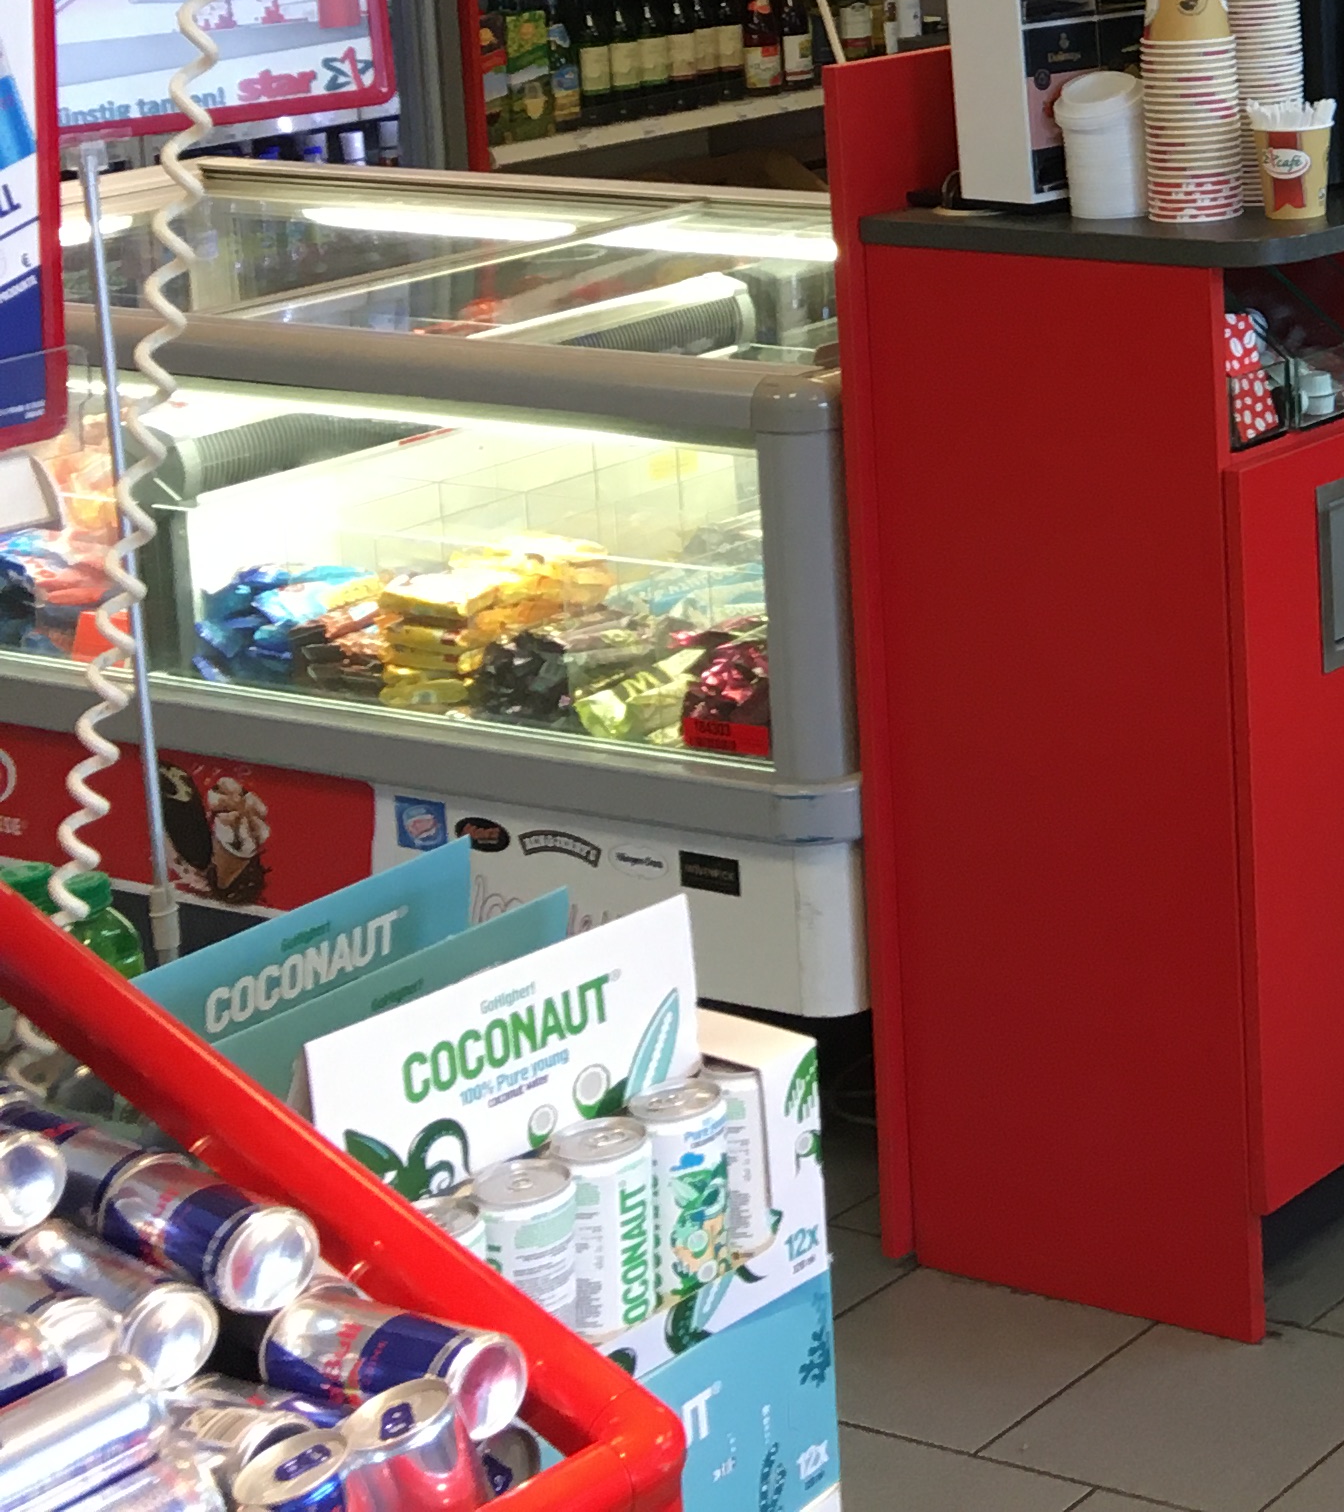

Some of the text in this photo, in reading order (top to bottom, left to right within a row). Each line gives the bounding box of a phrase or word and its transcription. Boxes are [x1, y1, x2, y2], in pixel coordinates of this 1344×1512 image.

[237, 69, 318, 102] star
[1277, 153, 1303, 172] café
[205, 913, 400, 1034] COCONAUT
[403, 971, 612, 1105] COCONAUT
[459, 1048, 570, 1106] 100% Pure young
[784, 1224, 819, 1262] 12x
